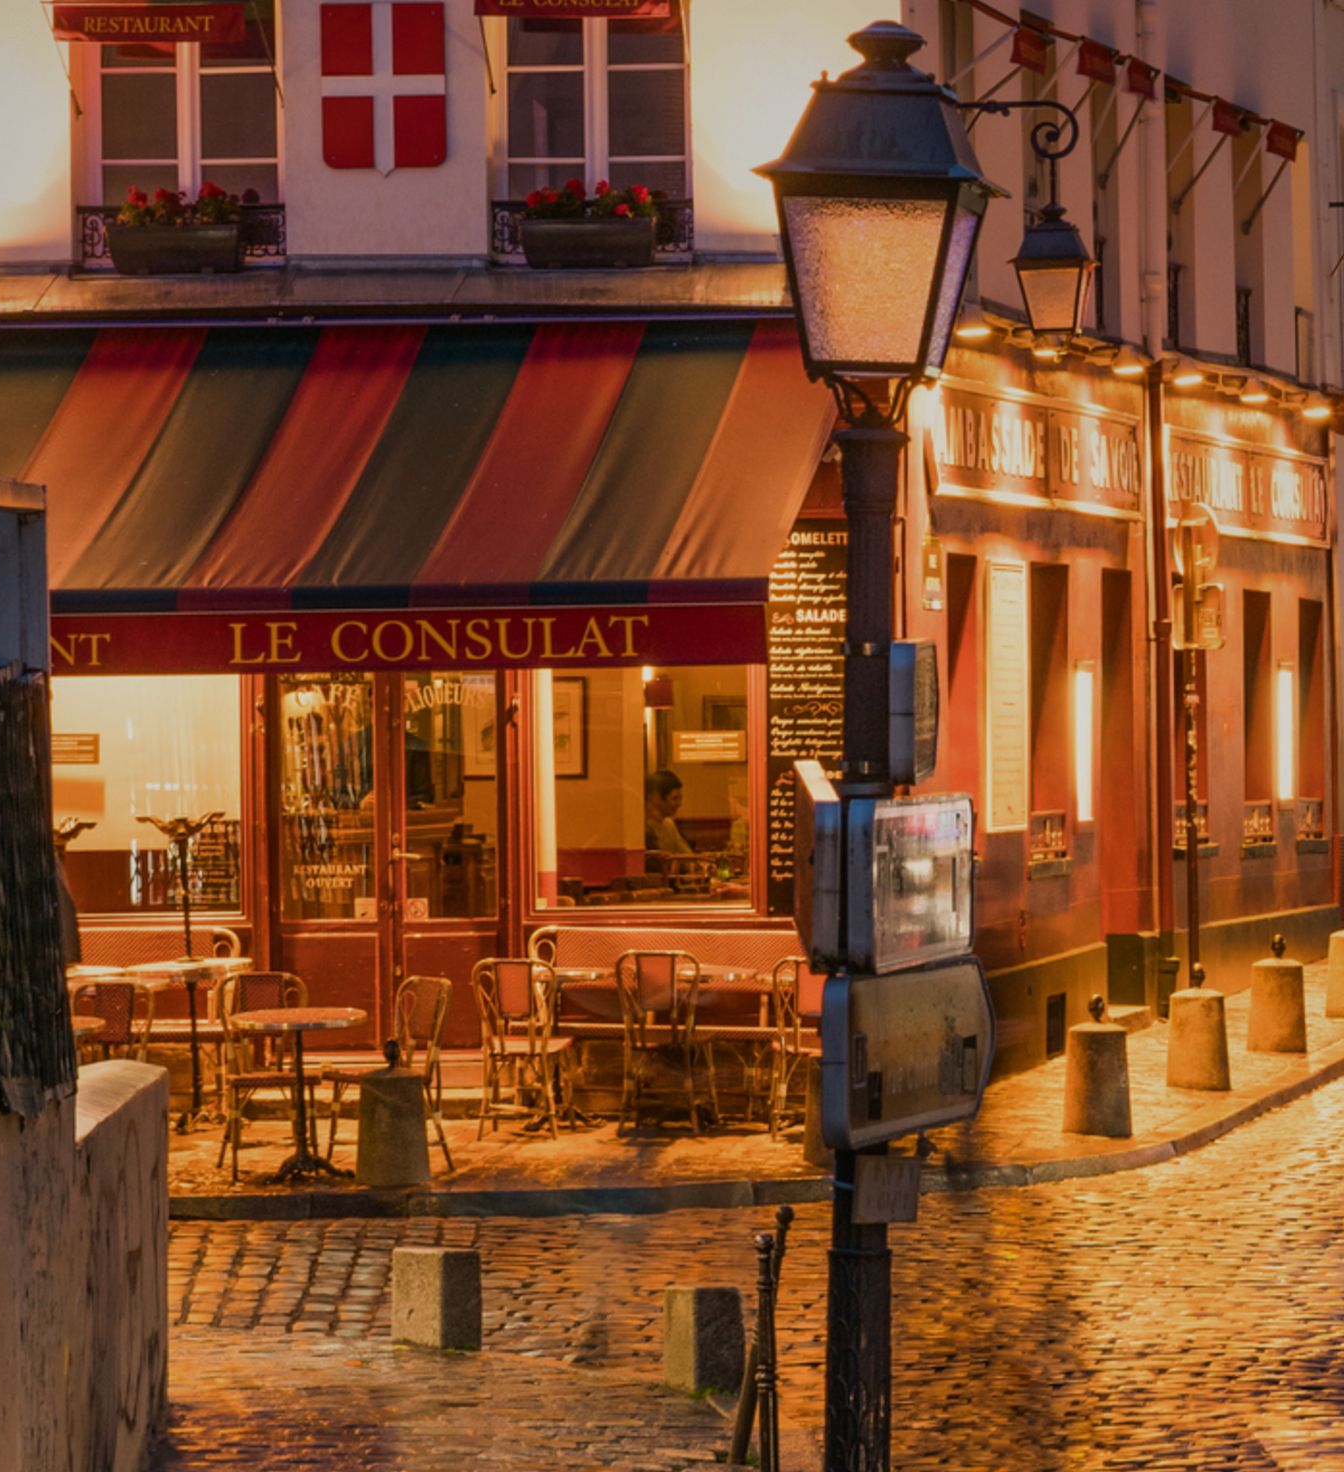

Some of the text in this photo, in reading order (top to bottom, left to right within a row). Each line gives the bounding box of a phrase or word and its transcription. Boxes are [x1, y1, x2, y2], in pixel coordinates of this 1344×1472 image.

[83, 14, 215, 33] RESTAURANT
[936, 404, 1046, 478] AMBASSADE
[1059, 424, 1080, 485] DE
[229, 615, 649, 664] LE CONSULAT
